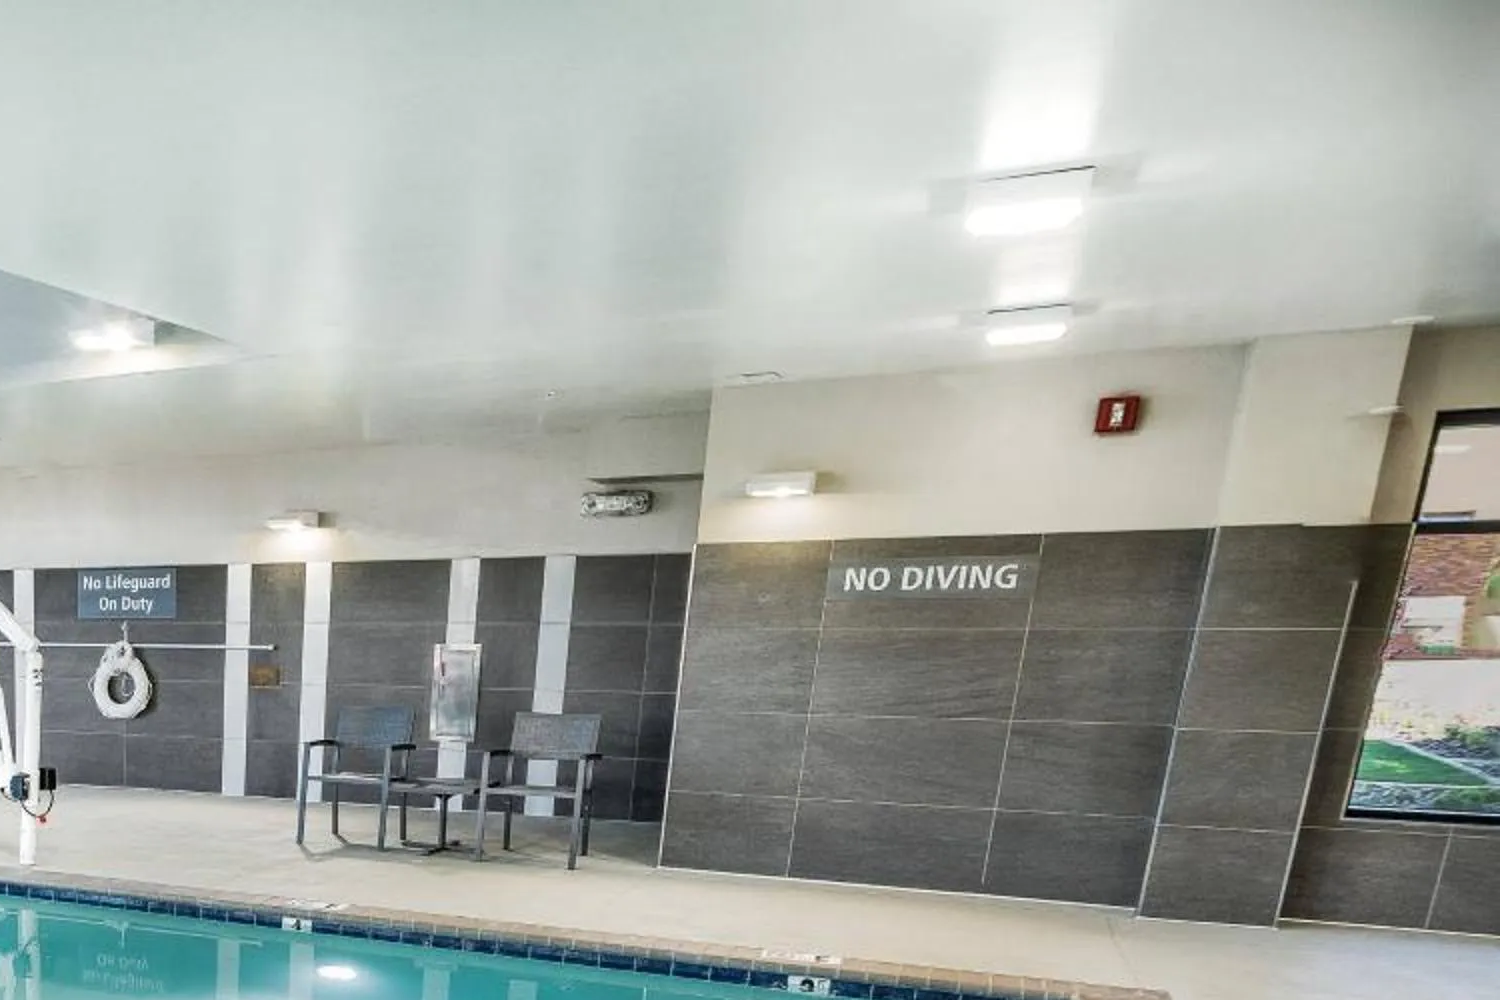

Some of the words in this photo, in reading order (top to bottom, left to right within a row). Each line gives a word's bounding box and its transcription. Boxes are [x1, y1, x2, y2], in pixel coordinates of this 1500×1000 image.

[83, 575, 101, 590] No
[106, 573, 171, 593] Lifeguard
[843, 567, 891, 592] NO
[900, 564, 1019, 591] DIVING
[99, 598, 117, 611] On
[121, 597, 153, 614] Duty
